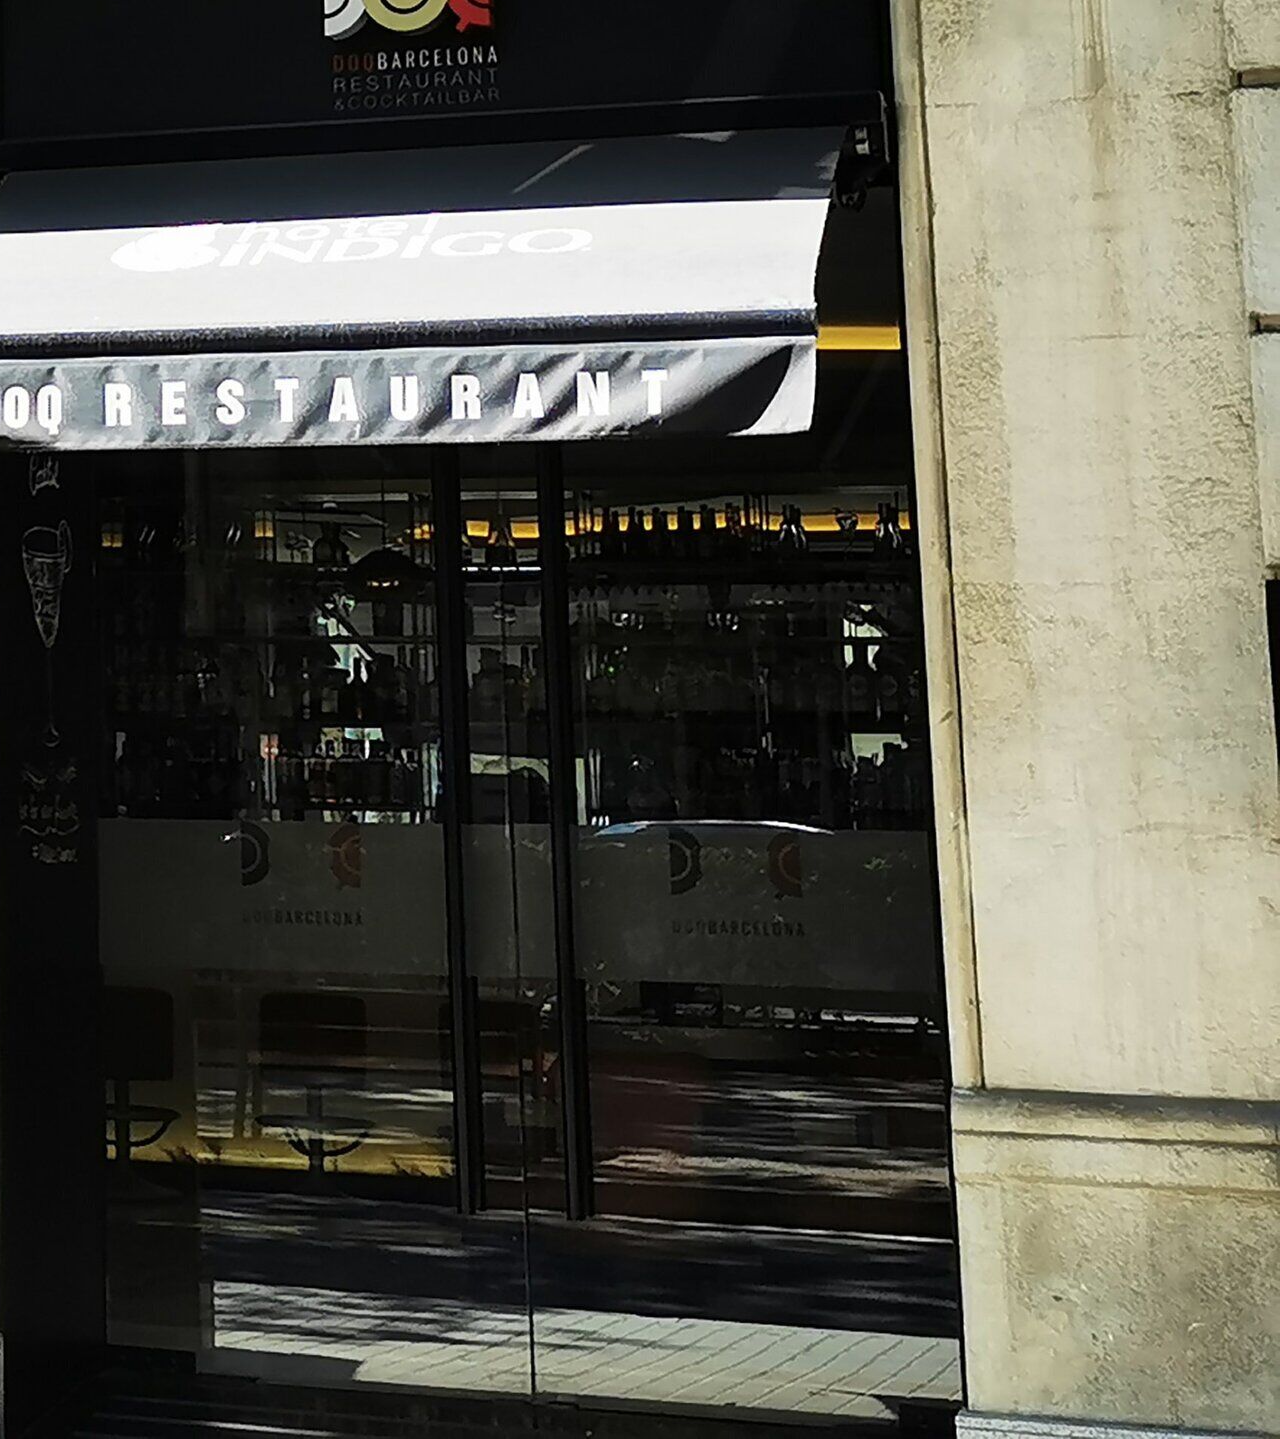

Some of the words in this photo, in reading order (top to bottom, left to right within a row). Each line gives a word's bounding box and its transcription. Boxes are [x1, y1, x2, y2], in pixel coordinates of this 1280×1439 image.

[333, 68, 499, 94] RESTAURANT
[219, 229, 594, 267] INDIGO
[101, 368, 670, 428] RESTAURANT
